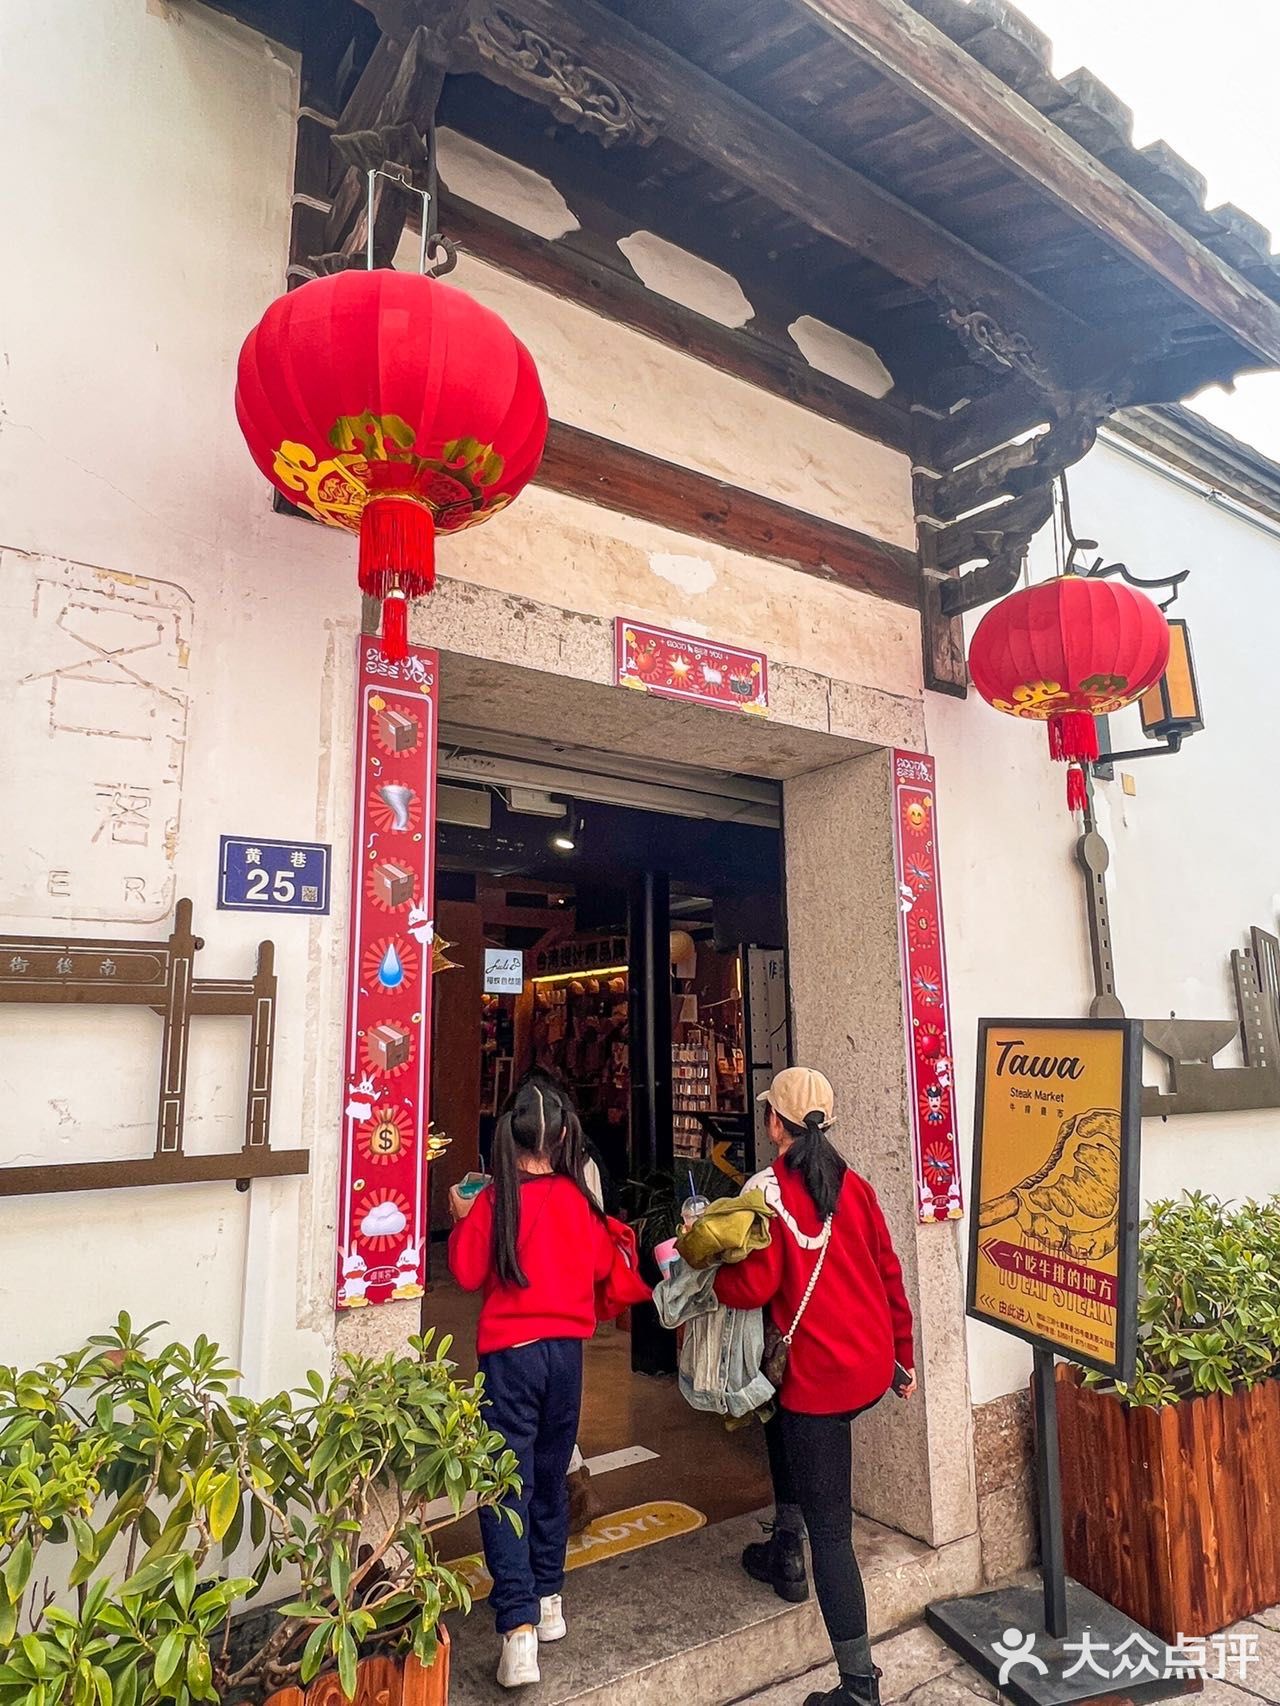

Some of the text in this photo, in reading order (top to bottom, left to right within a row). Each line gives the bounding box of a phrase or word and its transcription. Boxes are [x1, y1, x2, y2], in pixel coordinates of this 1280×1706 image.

[366, 648, 411, 668] GOD
[245, 847, 307, 868] 黄巷
[246, 868, 295, 902] 25
[996, 1040, 1085, 1080] Tawa
[1010, 1087, 1064, 1103] Steak Market
[1000, 1250, 1113, 1301] 一个吃牛排的地方
[998, 1300, 1034, 1326] 由此进入
